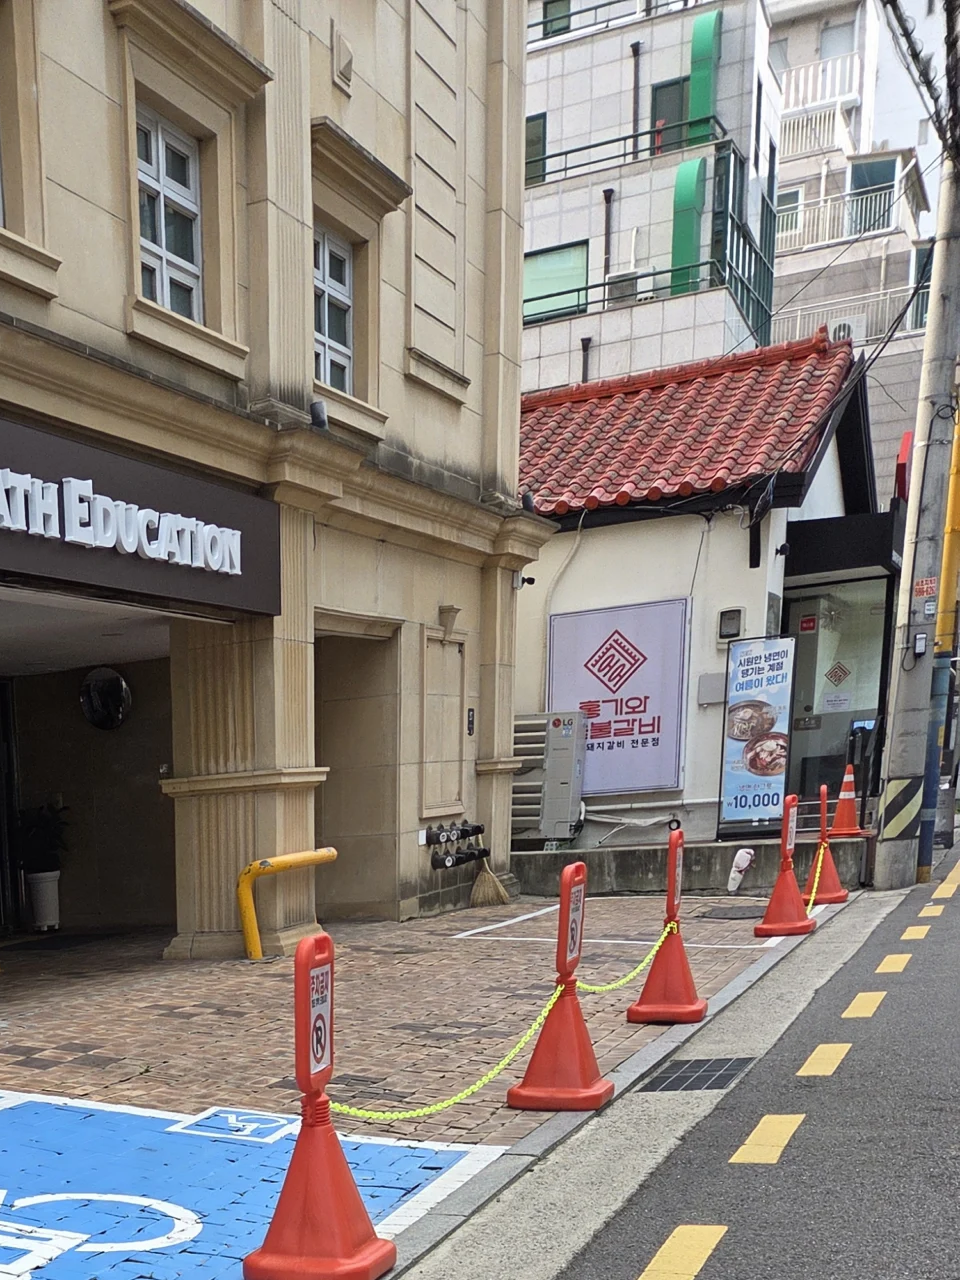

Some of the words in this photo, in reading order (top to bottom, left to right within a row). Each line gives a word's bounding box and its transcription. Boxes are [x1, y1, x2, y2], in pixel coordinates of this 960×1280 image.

[738, 655, 762, 668] 시원한
[764, 649, 788, 663] 냉면이
[767, 661, 783, 672] 계절
[735, 677, 763, 692] 여름이
[766, 672, 788, 687] 왔다!
[579, 696, 650, 719] 홍기와
[562, 718, 573, 726] LG
[585, 716, 661, 740] 불갈비
[631, 737, 660, 749] 전문점
